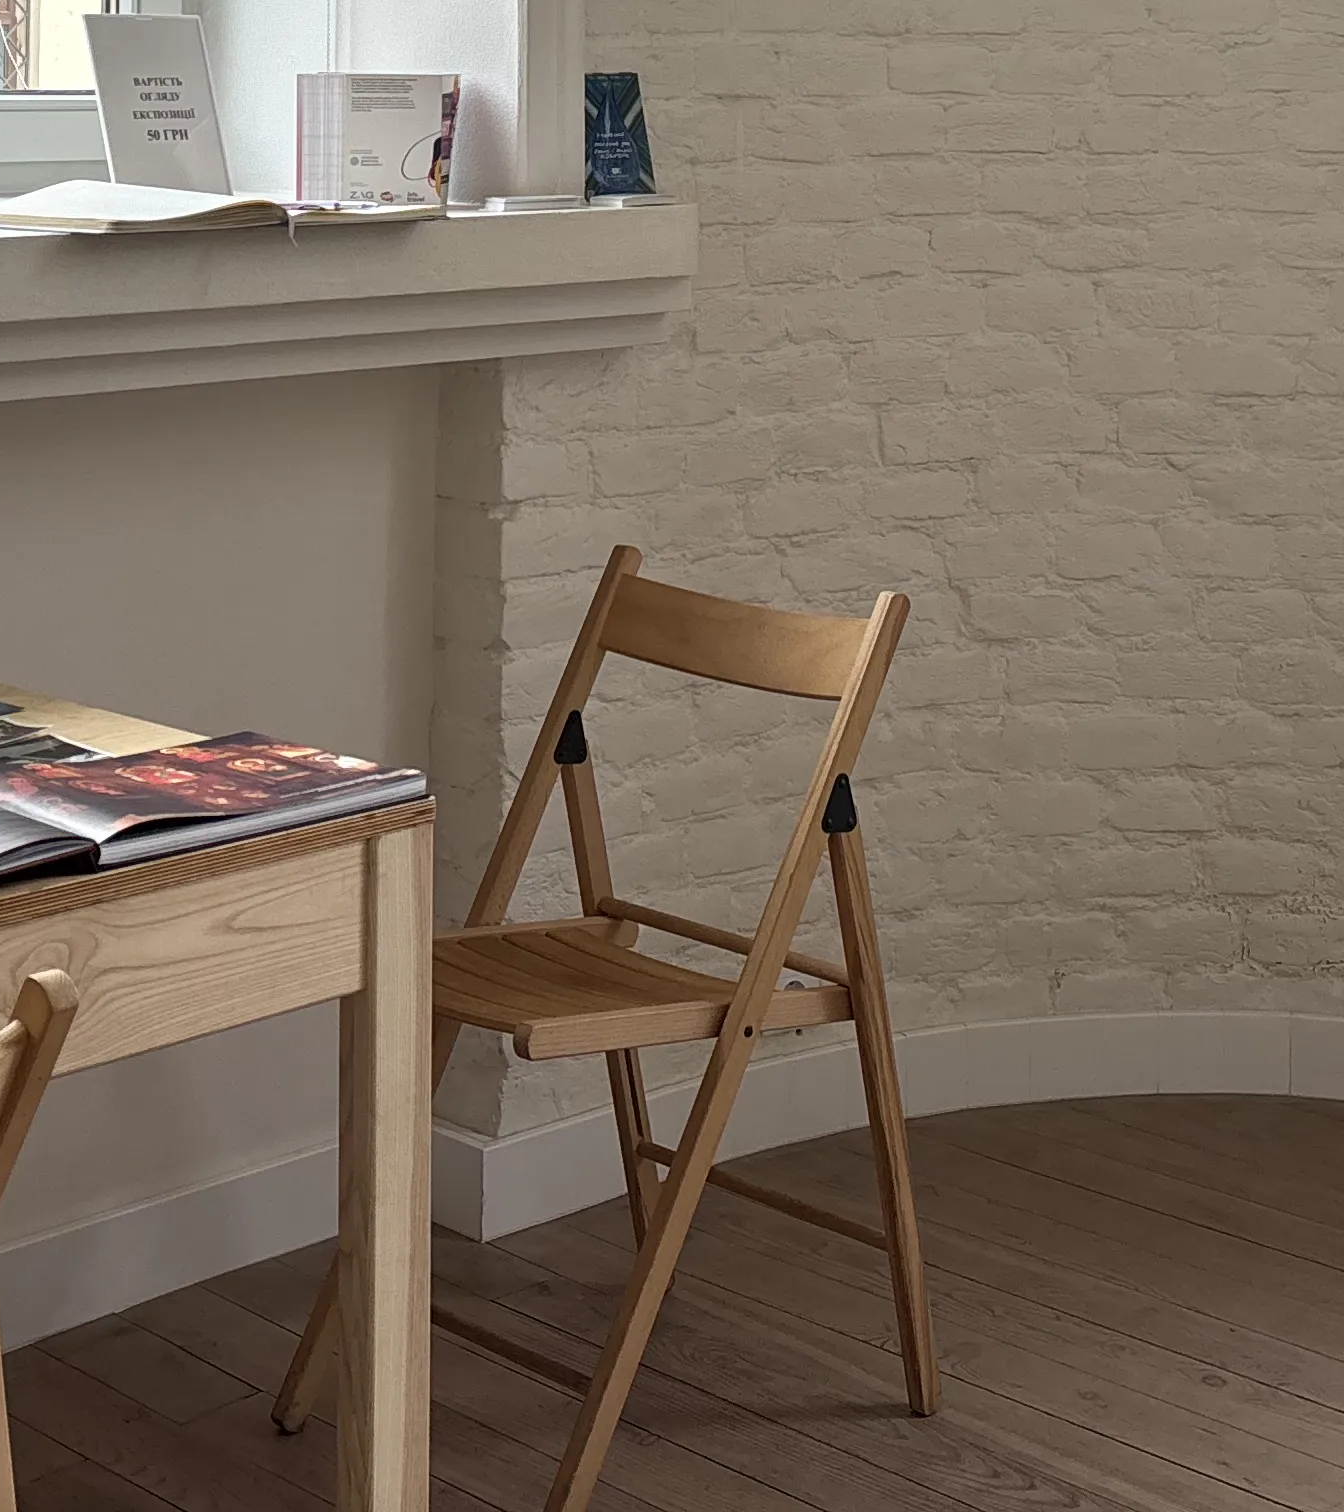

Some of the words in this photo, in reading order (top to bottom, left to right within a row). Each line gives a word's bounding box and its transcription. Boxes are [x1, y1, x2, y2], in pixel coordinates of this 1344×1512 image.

[133, 77, 183, 87] ВАРТІСТЬ
[140, 92, 181, 102] ОГЛЯДУ
[147, 129, 160, 141] 50
[163, 129, 189, 141] ГРН
